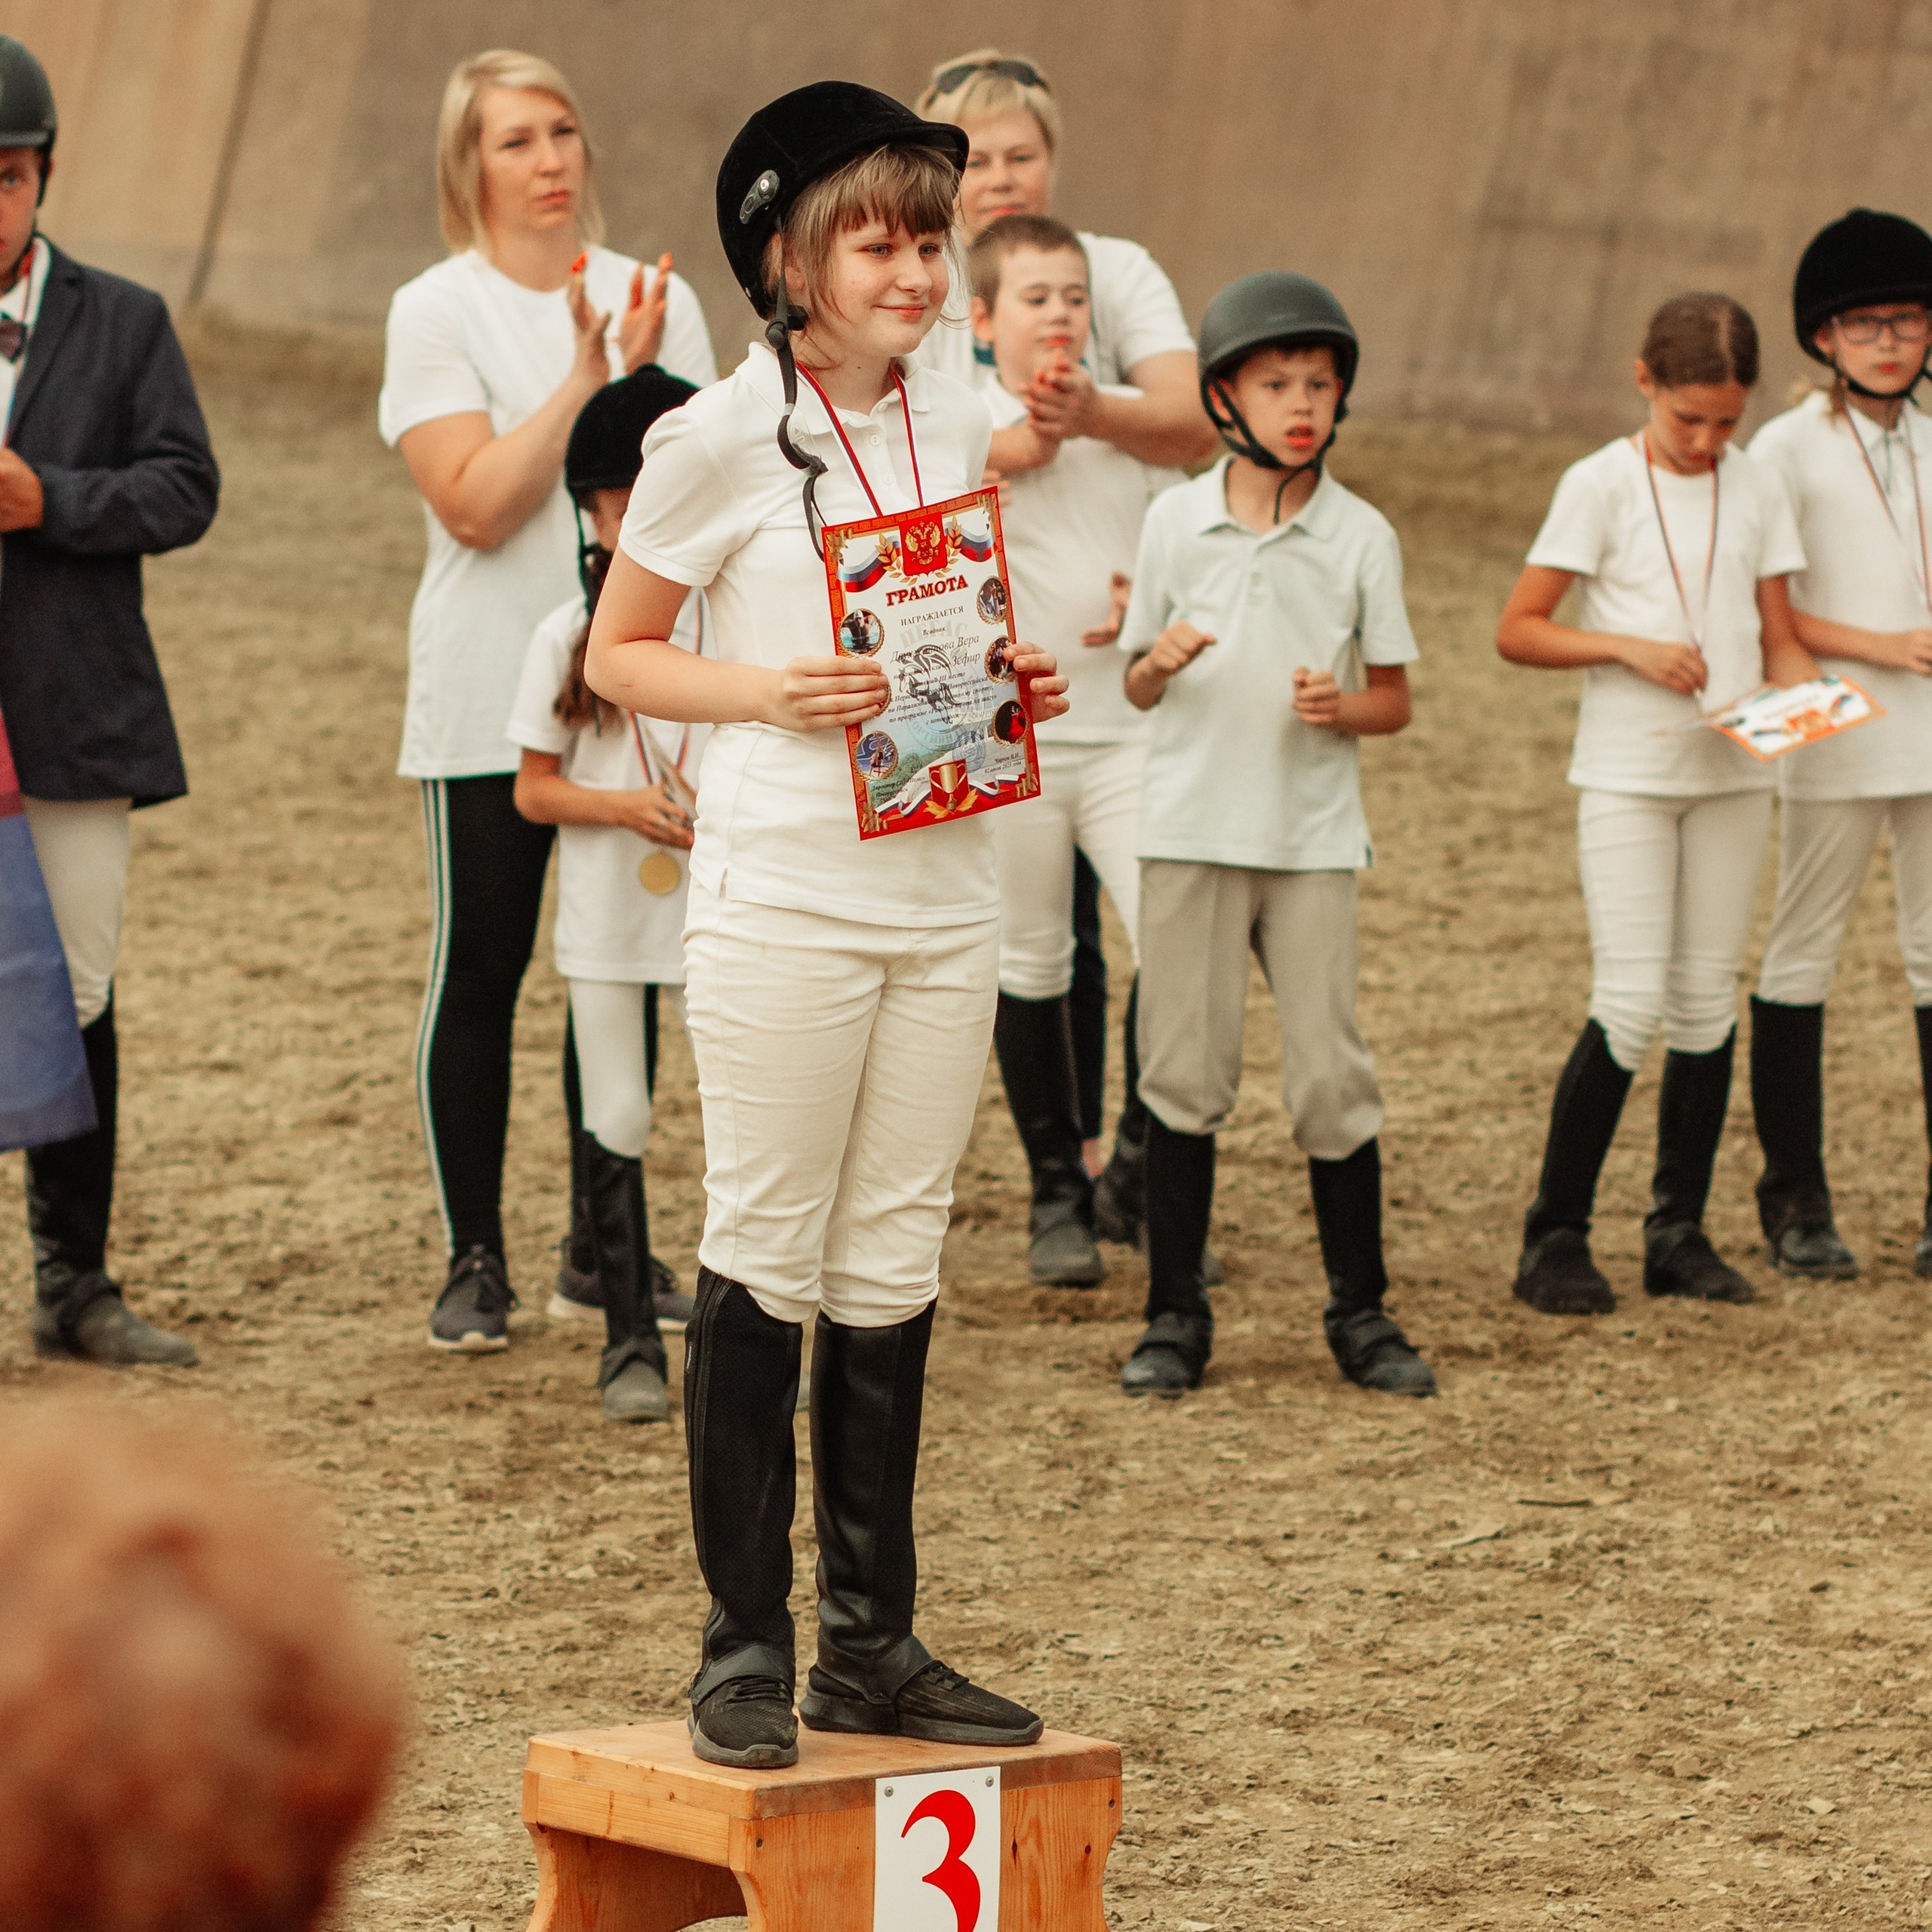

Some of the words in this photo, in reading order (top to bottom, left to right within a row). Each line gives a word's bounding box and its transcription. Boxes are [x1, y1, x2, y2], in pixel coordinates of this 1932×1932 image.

[885, 574, 968, 606] ГРАМОТА
[900, 605, 963, 626] НАГРАЖДАЕТСЯ
[957, 633, 980, 648] Вера
[952, 651, 980, 667] Зефир
[901, 1789, 980, 1932] 3
